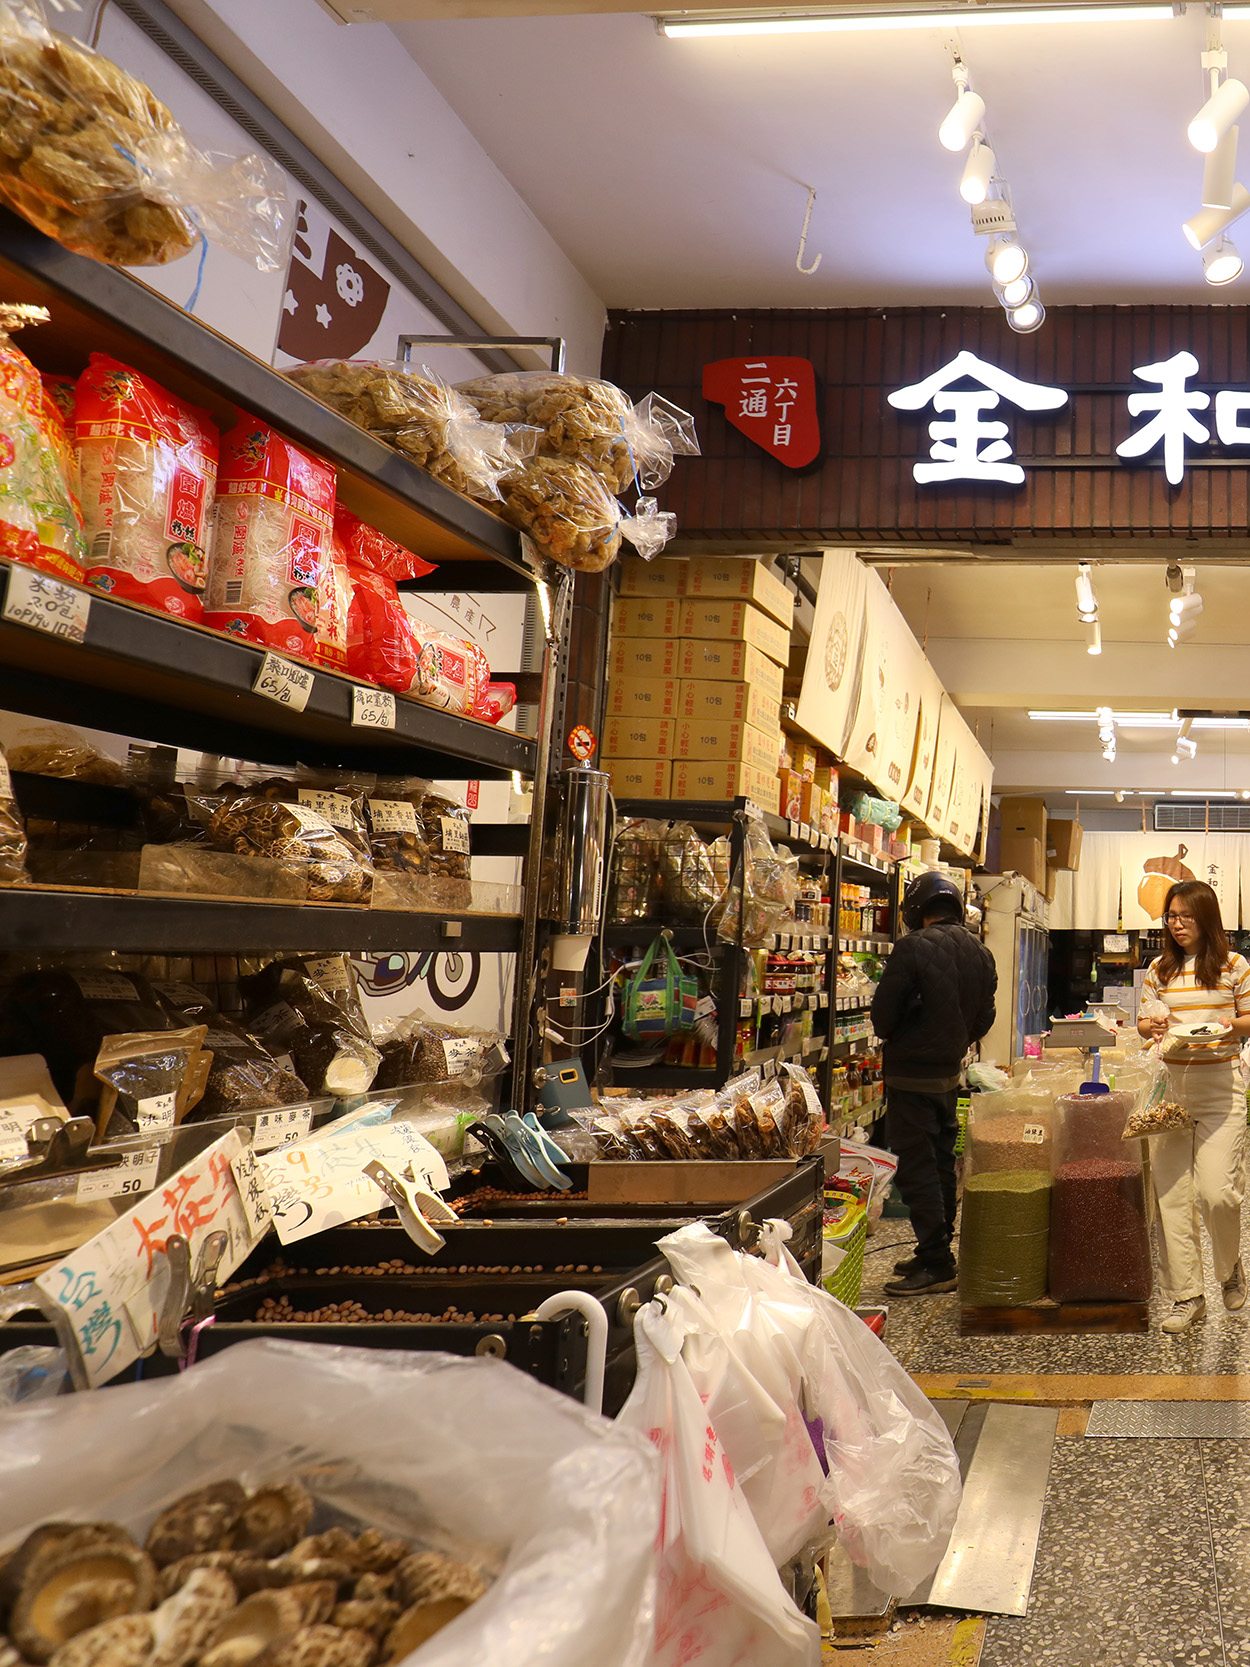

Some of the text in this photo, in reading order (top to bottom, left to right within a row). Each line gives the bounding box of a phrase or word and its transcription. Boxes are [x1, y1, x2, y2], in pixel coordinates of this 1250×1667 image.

[739, 362, 771, 418] 二通
[773, 378, 799, 447] 六丁目
[648, 573, 665, 582] 10包
[713, 573, 729, 581] 10包
[449, 594, 475, 626] 農產
[638, 613, 653, 621] 10包
[704, 614, 720, 623] 10包
[636, 653, 652, 662] 10包
[704, 654, 720, 663] 10包
[634, 693, 651, 702] 10包
[705, 697, 722, 705] 10包
[630, 733, 646, 742] 10包
[700, 736, 717, 745] 10包
[625, 775, 642, 784] 10包
[697, 776, 714, 785] 10包
[259, 1109, 311, 1127] 濃味麥茶
[284, 1131, 299, 1144] 50
[121, 1178, 142, 1194] 50
